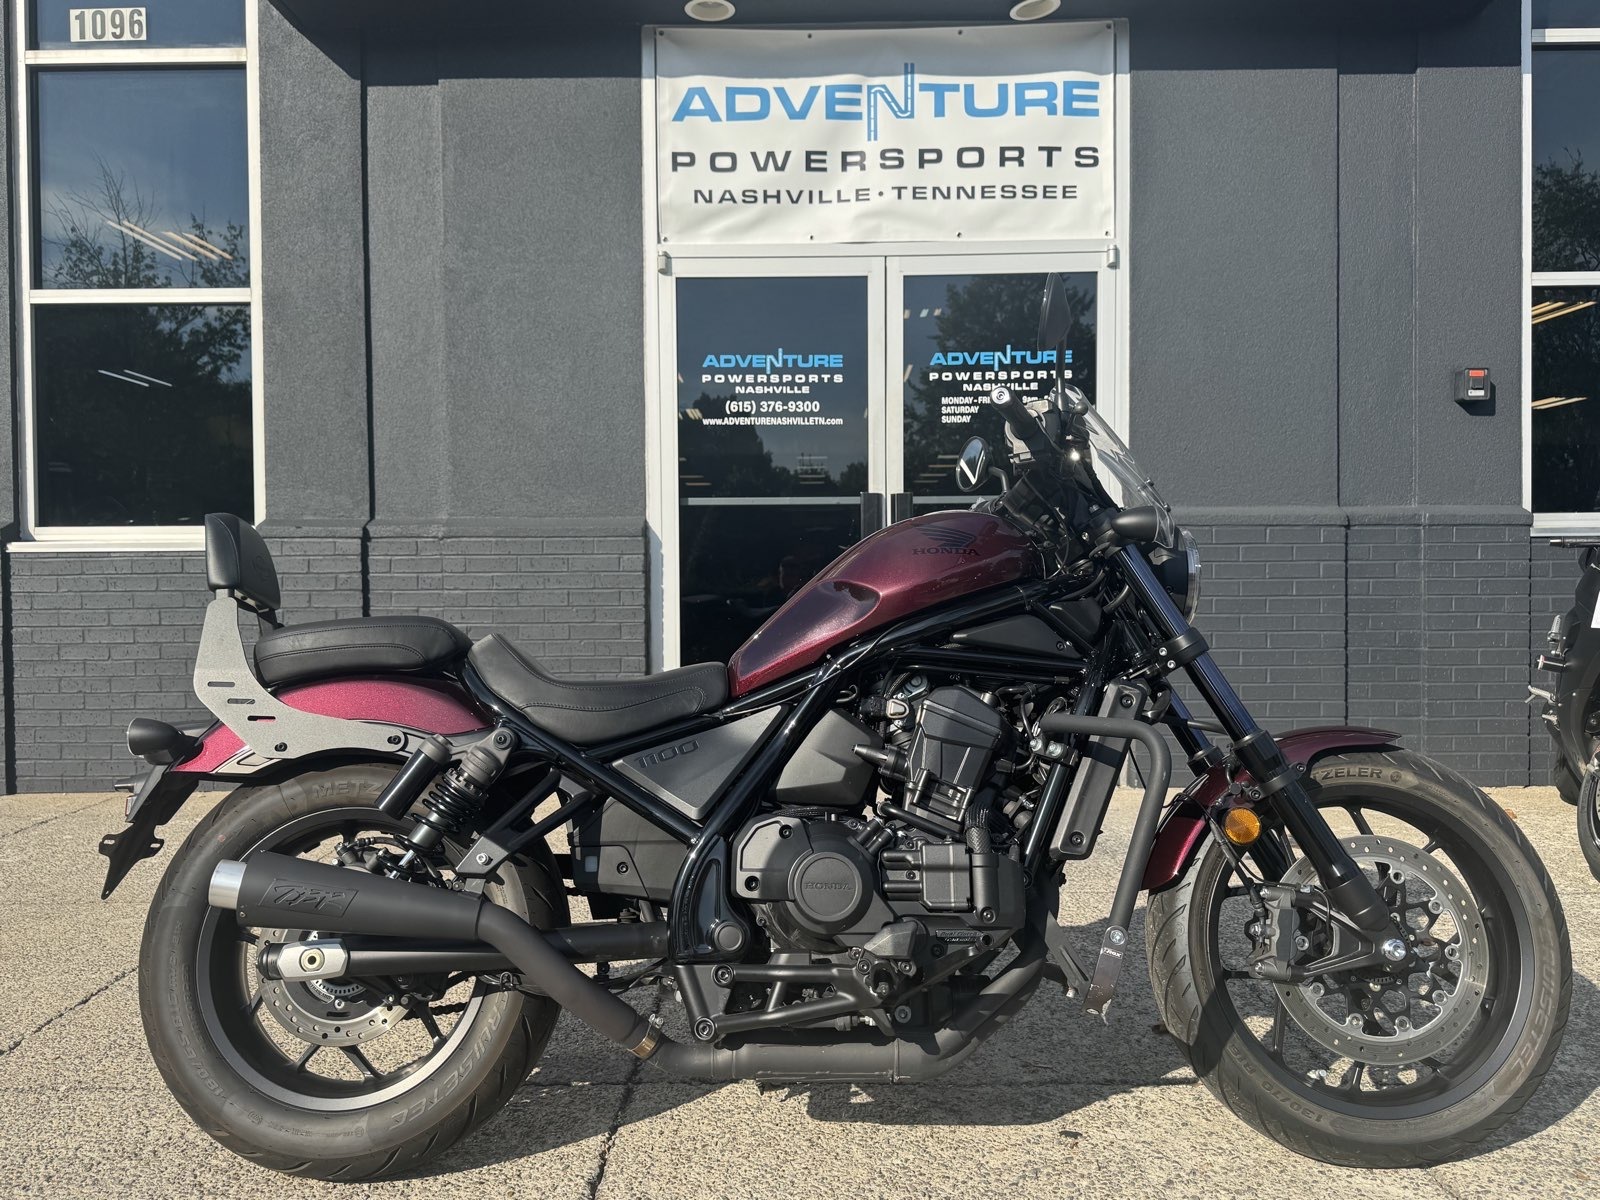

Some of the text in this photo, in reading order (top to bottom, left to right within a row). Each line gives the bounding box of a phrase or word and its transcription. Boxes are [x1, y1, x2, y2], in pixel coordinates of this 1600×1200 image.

[74, 9, 144, 40] 1096
[671, 62, 1101, 141] ADVENTURE
[671, 146, 1100, 172] POWERSPORTS
[693, 184, 1078, 204] NASHVILLE TENNESSEE
[702, 348, 844, 374] ADVENTURE
[702, 374, 844, 384] POWERSPORTS
[735, 386, 810, 394] NASHVILLE
[725, 400, 820, 414] (615) 376-9300
[941, 405, 979, 414] SATURDAY
[702, 416, 844, 426] www.ADVENTURENASHVILLETN.com
[941, 415, 971, 424] SUNDAY
[912, 547, 980, 556] HONDA
[634, 740, 699, 768] 1100
[804, 881, 853, 890] HONDA
